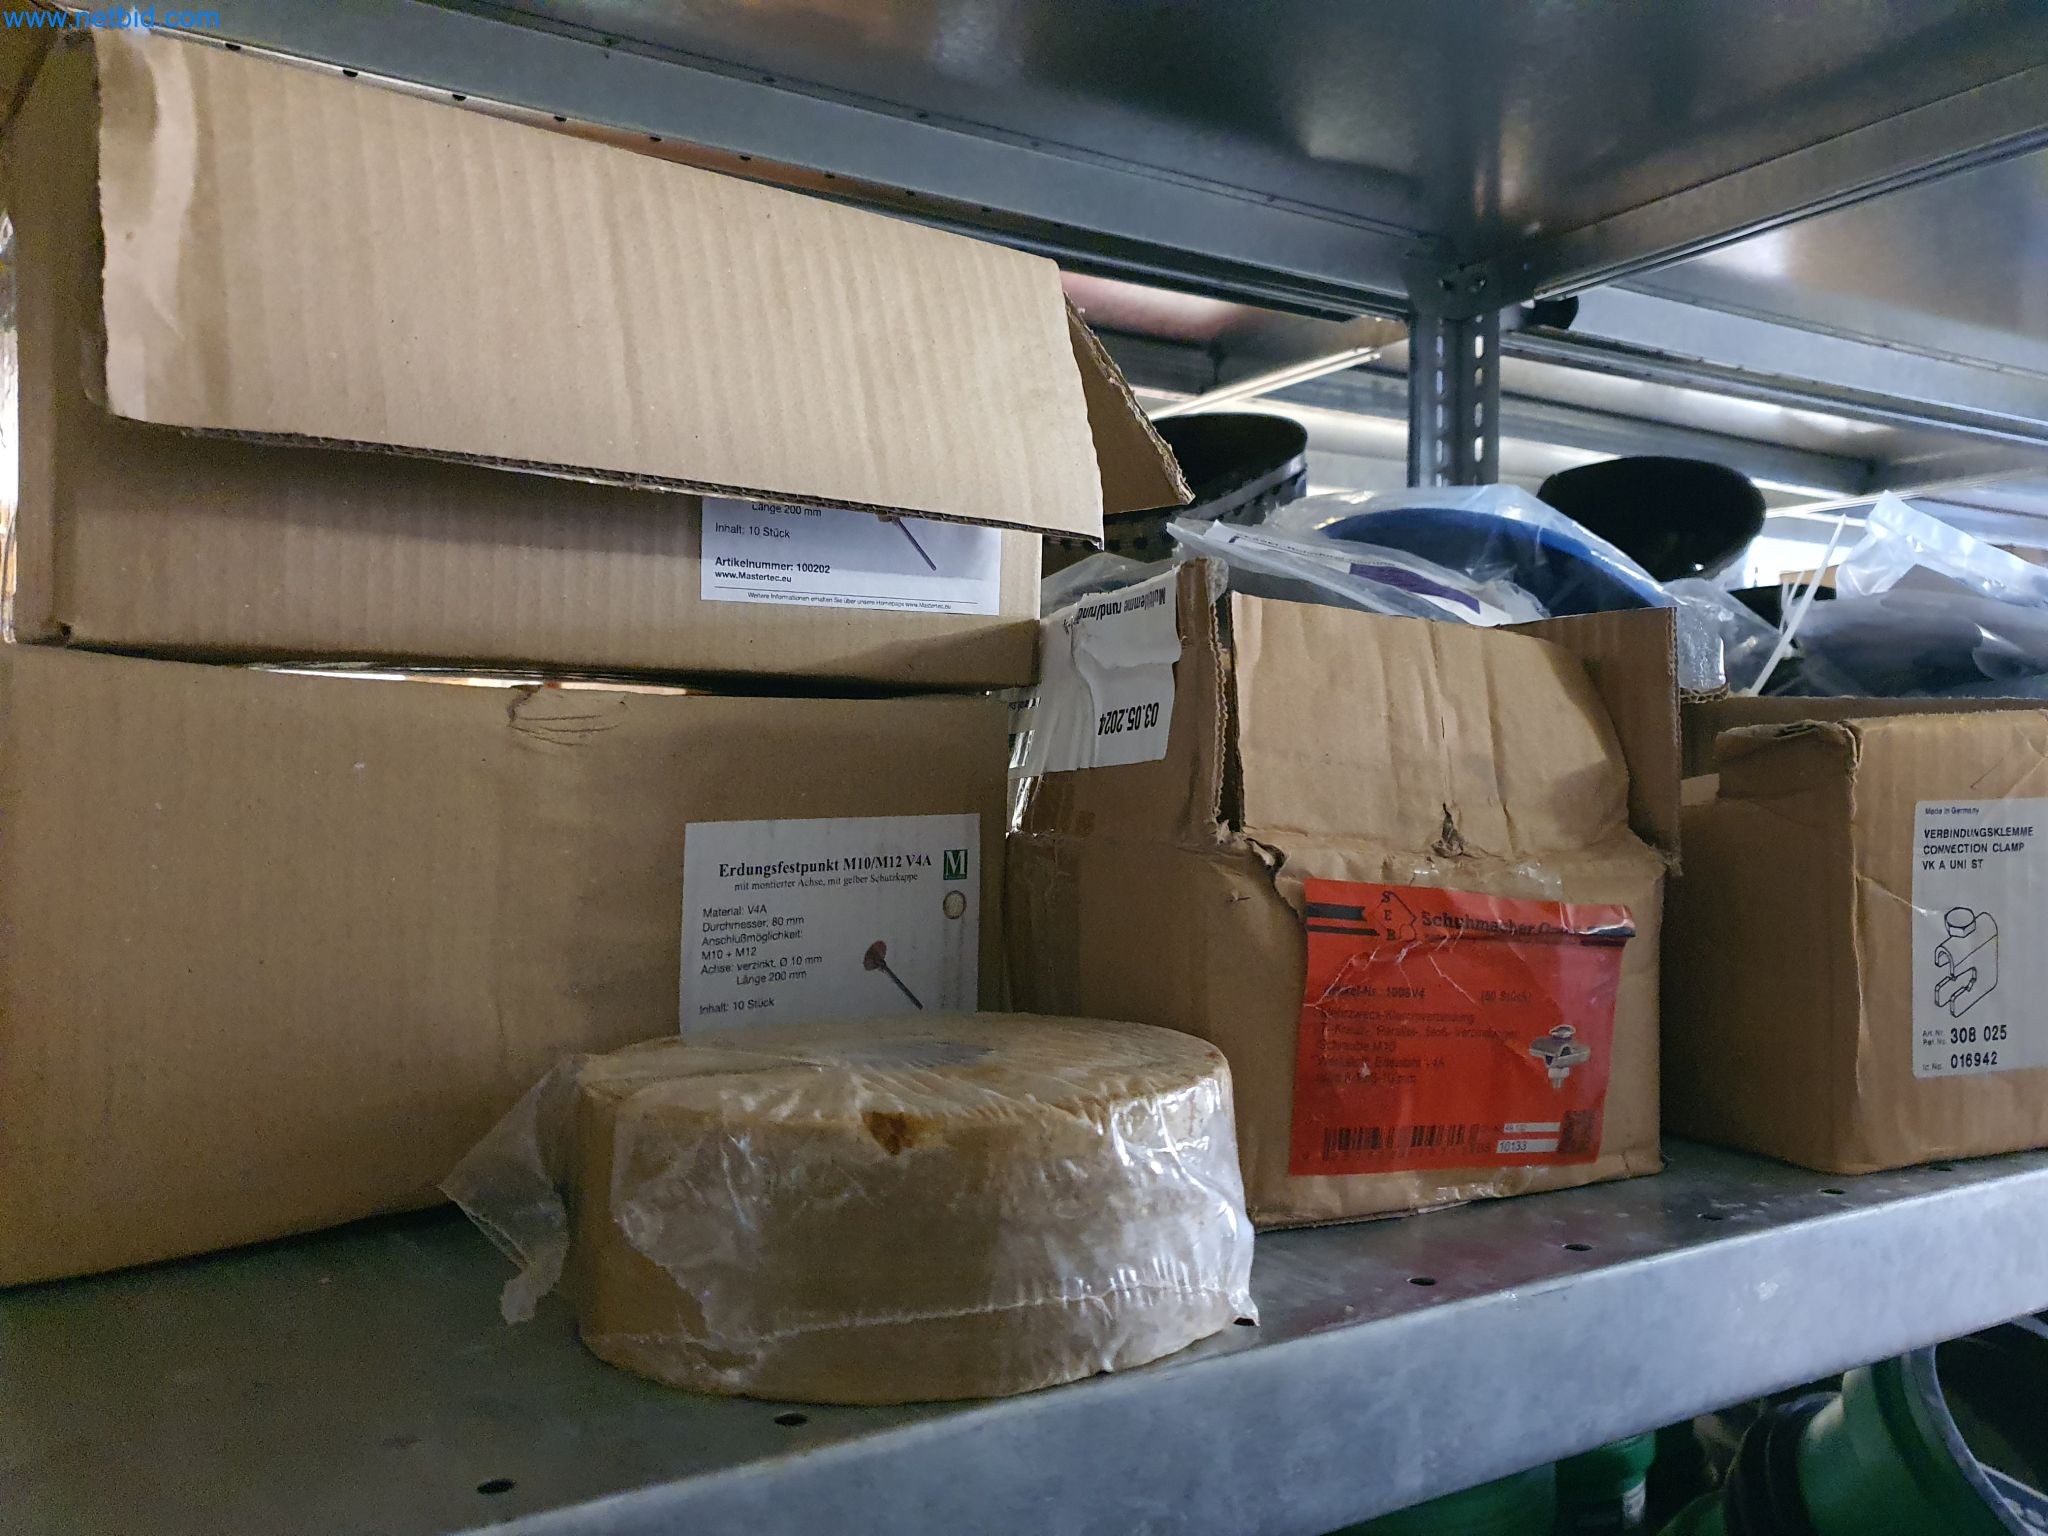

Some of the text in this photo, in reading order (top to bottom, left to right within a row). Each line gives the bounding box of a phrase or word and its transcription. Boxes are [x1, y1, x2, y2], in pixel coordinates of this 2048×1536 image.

[804, 507, 822, 517] mm
[715, 522, 790, 540] Inhalt: 10 Stück
[715, 557, 831, 574] Artikelnummer: 100202
[715, 570, 792, 583] www.Mastertec.eu
[1098, 702, 1160, 736] 03.05.2024
[1925, 805, 1980, 816] Made in Germany
[1924, 826, 2033, 840] VERBINDUNGSKLEMME
[1923, 842, 2025, 855] CONNECTION CLAMP
[719, 854, 932, 878] Erdungsfestpunkt M10/M12 V4A
[1922, 859, 1983, 870] VK A UNI ST
[734, 882, 749, 891] mit
[752, 880, 796, 890] montierter
[827, 877, 841, 885] mit
[703, 904, 767, 918] Material: V4A
[772, 917, 784, 927] 80
[786, 916, 804, 925] mm
[702, 949, 723, 960] M10
[735, 947, 757, 957] M12
[791, 955, 803, 966] 10
[805, 955, 822, 965] mm
[736, 971, 807, 986] Länge 200 mm
[700, 997, 775, 1015] Inhalt: 10 Stück
[1950, 1026, 1977, 1044] 308
[1983, 1024, 2008, 1042] 025
[1950, 1051, 1998, 1069] 016942
